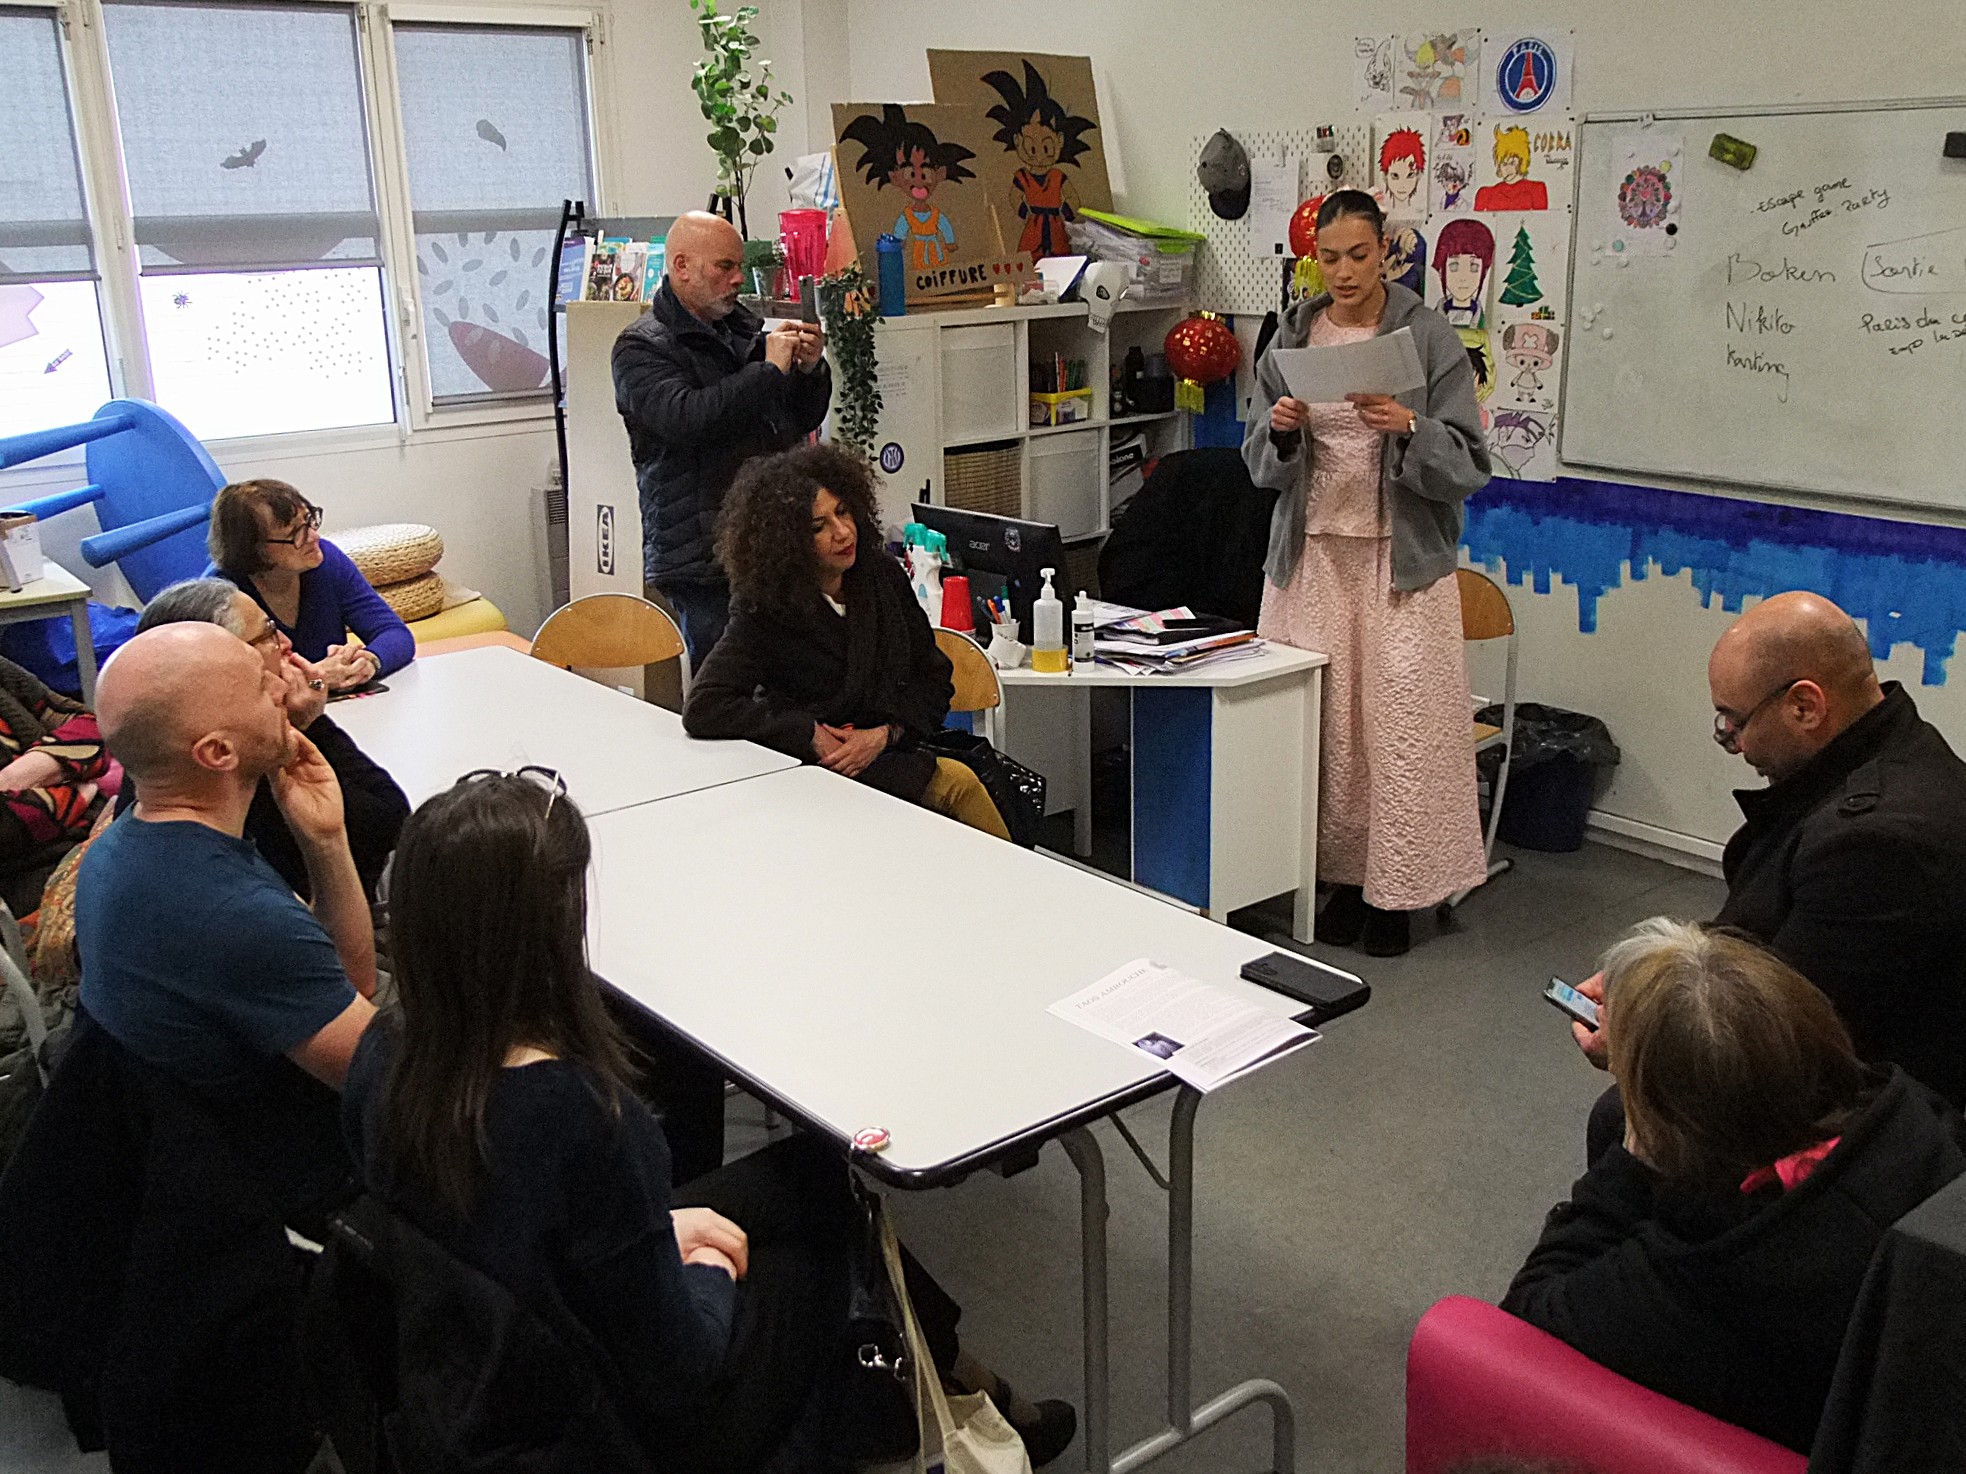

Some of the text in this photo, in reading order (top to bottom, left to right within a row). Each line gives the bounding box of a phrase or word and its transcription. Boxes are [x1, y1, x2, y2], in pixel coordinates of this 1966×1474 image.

[1533, 130, 1572, 153] COBRA
[1814, 178, 1852, 203] game
[969, 540, 990, 551] acer
